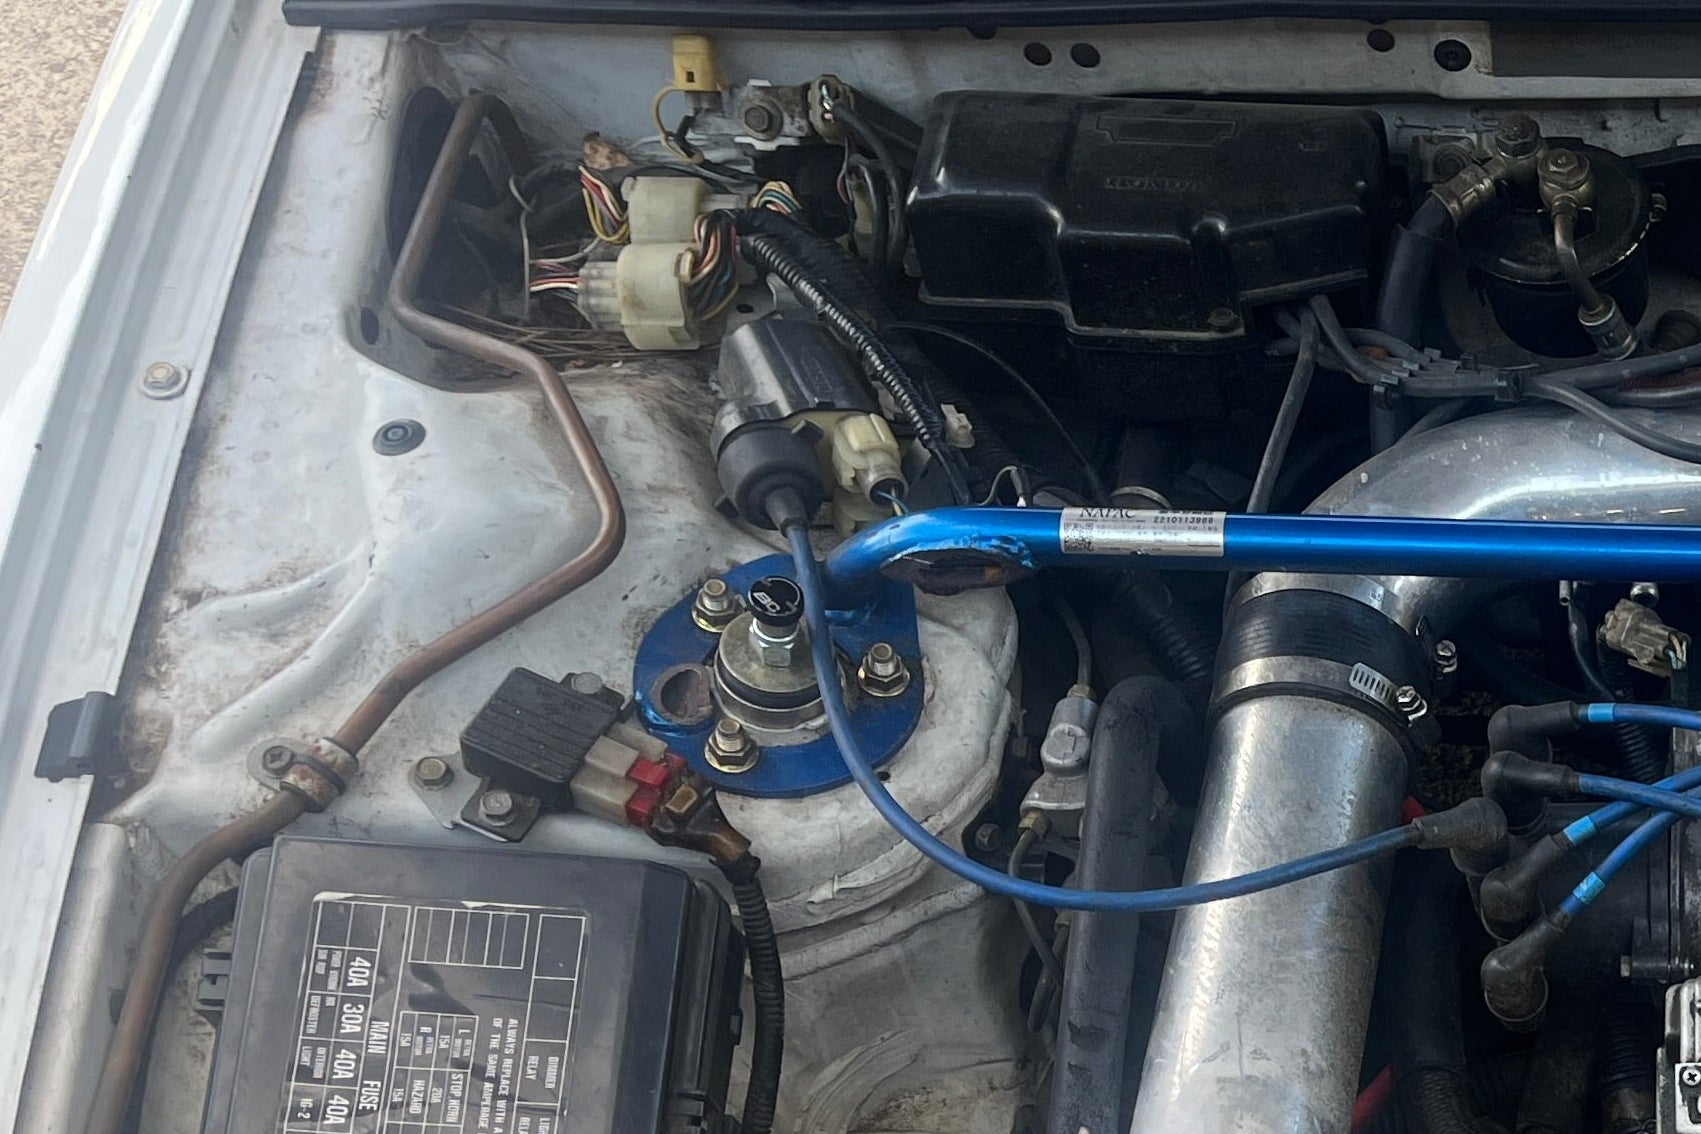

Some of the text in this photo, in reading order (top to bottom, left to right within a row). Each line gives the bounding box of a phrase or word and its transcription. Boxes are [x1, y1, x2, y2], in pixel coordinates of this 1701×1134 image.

[346, 956, 372, 987] 40A
[339, 1003, 365, 1034] 30A
[492, 1017, 504, 1029] OF
[399, 1032, 412, 1047] 15A
[438, 1035, 451, 1049] 15A
[489, 1033, 501, 1050] THE
[504, 1018, 519, 1055] ALWAYS
[331, 1048, 357, 1079] 40A
[358, 1020, 390, 1111] MAIN FUSE
[484, 1053, 499, 1078] SAME
[525, 1055, 540, 1080] RELAY
[497, 1058, 514, 1096] REPLACE
[297, 1097, 314, 1119] IG-2
[391, 1088, 405, 1103] 15A
[408, 1079, 426, 1114] HAZARD
[430, 1087, 443, 1104] 20A
[477, 1081, 494, 1129] AMPERAGE
[322, 1094, 350, 1125] 40A
[494, 1099, 507, 1124] WITH
[493, 1126, 504, 1134] A
